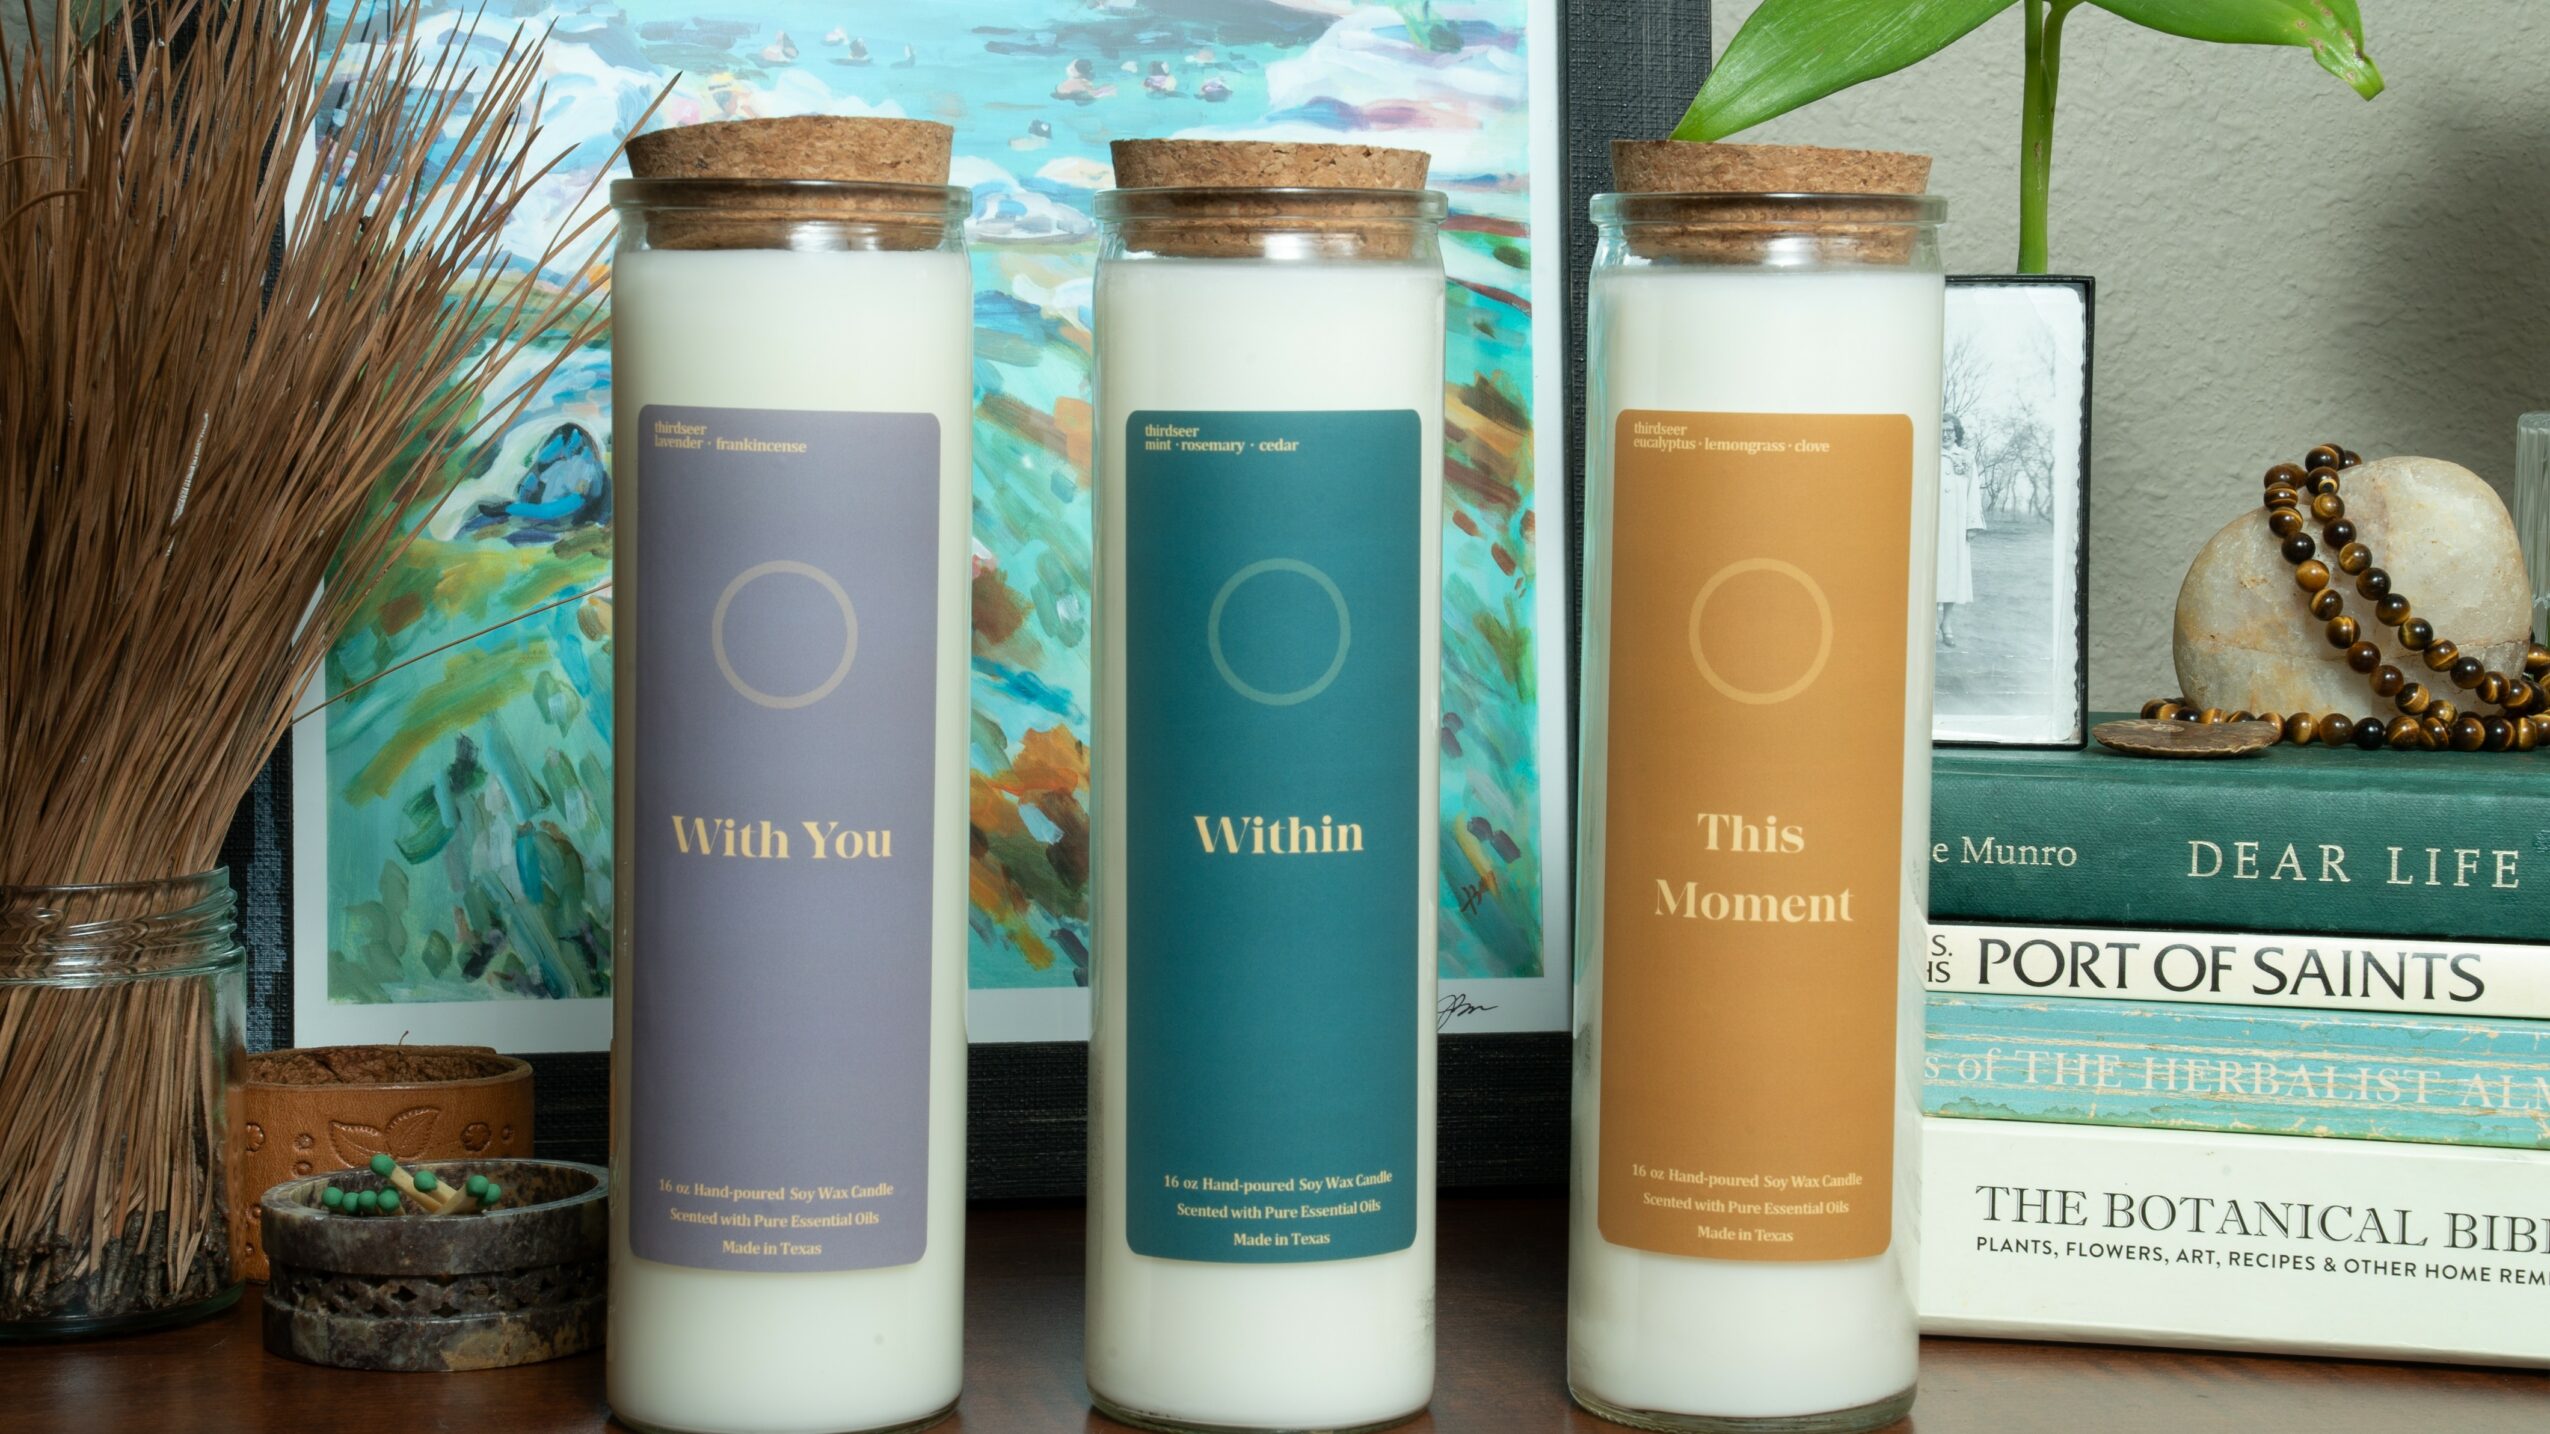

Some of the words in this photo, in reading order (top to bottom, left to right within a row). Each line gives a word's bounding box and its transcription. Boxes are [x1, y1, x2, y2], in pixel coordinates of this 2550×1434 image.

[654, 421, 707, 436] thirdseer
[1145, 424, 1200, 438] thirdseer
[1634, 421, 1687, 436] thirdseer
[654, 435, 704, 450] lavender
[716, 437, 807, 453] frankincense
[1145, 439, 1171, 451] mint
[1181, 439, 1245, 455] rosemary
[1259, 438, 1299, 451] cedar
[1633, 436, 1696, 452] eucalyptus
[1704, 437, 1785, 455] lemongrass
[1795, 440, 1830, 453] clove
[671, 815, 790, 859] With
[801, 821, 893, 859] You
[1194, 815, 1364, 854] Within
[1697, 813, 1805, 853] This
[1960, 836, 2078, 867] Munro
[2187, 839, 2351, 883] DEAR
[2386, 845, 2521, 889] LIFE
[1655, 878, 1855, 923] Moment
[1978, 938, 2140, 989] PORT
[2153, 943, 2237, 993] OF
[2252, 946, 2486, 1002] SAINTS
[1957, 1047, 2002, 1081] of
[2014, 1049, 2123, 1089] THE
[2144, 1055, 2440, 1106] HERBALIST
[659, 1178, 673, 1192] 16
[676, 1183, 690, 1195] oz
[694, 1183, 785, 1202] Hand-poured
[790, 1188, 815, 1203] Soy
[818, 1187, 849, 1200] Wax
[851, 1183, 894, 1198] Candle
[1163, 1175, 1179, 1188] 16
[1183, 1178, 1199, 1190] oz
[1203, 1177, 1294, 1195] Hand-poured
[1299, 1178, 1323, 1193] Soy
[1325, 1176, 1354, 1190] Wax
[1356, 1170, 1393, 1186] Candle
[1632, 1164, 1647, 1178] 16
[1650, 1169, 1665, 1180] oz
[1668, 1168, 1759, 1188] Hand-poured
[1764, 1175, 1788, 1192] Soy
[1791, 1175, 1820, 1189] Wax
[1822, 1172, 1863, 1187] Candle
[1177, 1203, 1228, 1218] Scented
[1231, 1207, 1262, 1219] with
[1265, 1206, 1298, 1219] Pure
[1301, 1201, 1358, 1218] Essential
[1360, 1199, 1381, 1213] Oils
[1643, 1192, 1692, 1210] Scented
[1694, 1199, 1725, 1213] with
[1728, 1201, 1762, 1215] Pure
[1764, 1202, 1824, 1216] Essential
[1826, 1200, 1849, 1214] Oils
[1975, 1185, 2088, 1226] THE
[2102, 1191, 2429, 1248] BOTANICAL
[670, 1208, 717, 1225] Scented
[720, 1213, 751, 1227] with
[754, 1215, 788, 1228] Pure
[791, 1212, 852, 1228] Essential
[855, 1211, 880, 1225] Oils
[1233, 1232, 1272, 1246] Made
[1275, 1232, 1288, 1246] in
[1291, 1232, 1331, 1246] Texas
[1697, 1225, 1736, 1241] Made
[1738, 1227, 1752, 1241] in
[1755, 1229, 1794, 1242] Texas
[722, 1240, 761, 1255] Made
[763, 1242, 777, 1255] in
[780, 1242, 822, 1255] Texas
[1976, 1236, 2060, 1258] PLANTS,
[2066, 1242, 2169, 1265] FLOWERS,
[2175, 1248, 2221, 1268] ART,
[2229, 1251, 2316, 1272] RECIPES
[2323, 1257, 2337, 1273] &
[2344, 1258, 2417, 1278] OTHER
[2425, 1263, 2491, 1282] HOME
